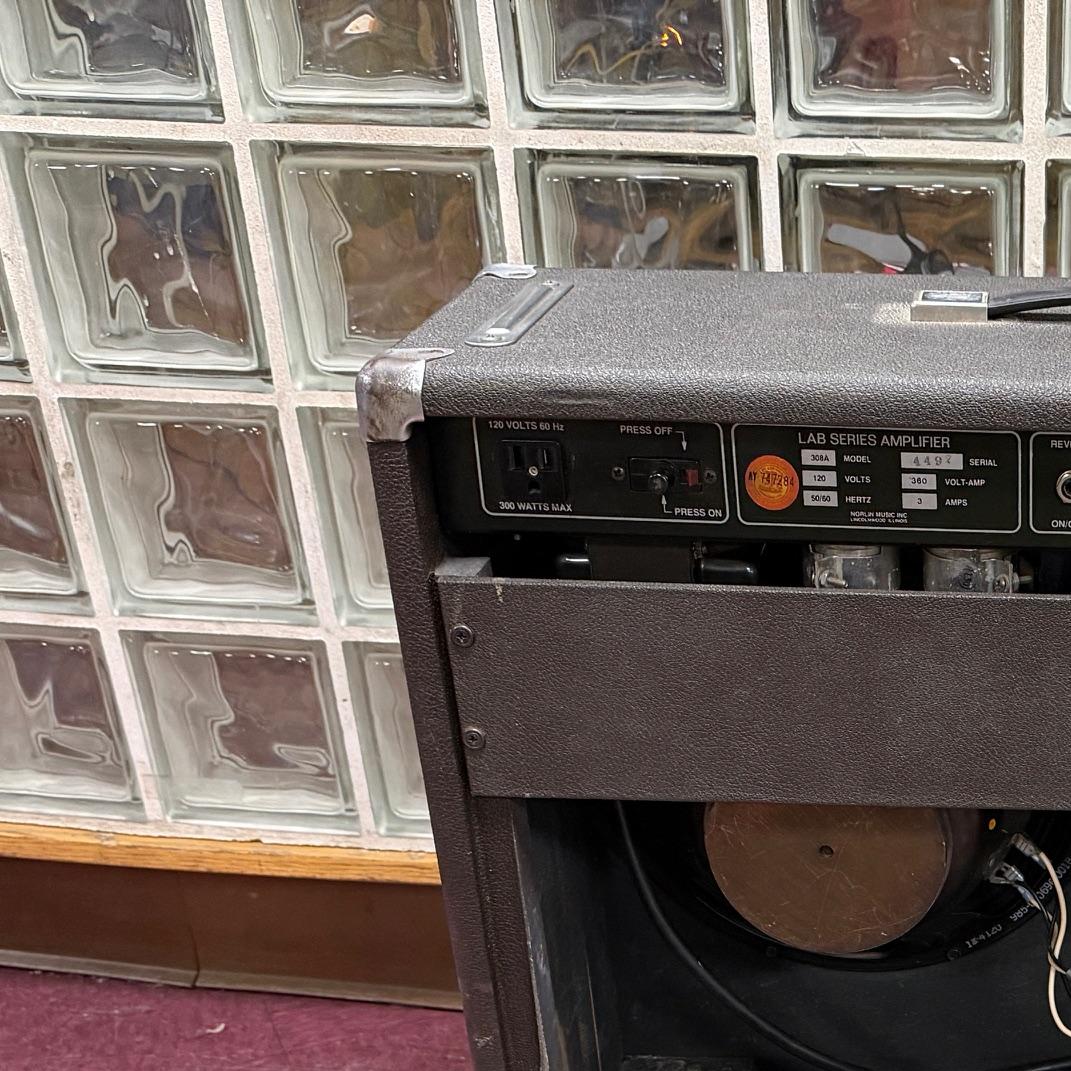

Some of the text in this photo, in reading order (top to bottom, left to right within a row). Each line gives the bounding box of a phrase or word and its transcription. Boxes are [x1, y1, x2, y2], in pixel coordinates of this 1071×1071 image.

[488, 421, 564, 432] 120 VOLTS 60 Hz
[620, 425, 673, 435] PRESS OFF
[798, 432, 951, 448] LAB SERIES AMPLIFIER
[810, 454, 830, 462] 308A
[843, 455, 872, 463] MODEL
[969, 458, 998, 467] SERIAL
[813, 475, 827, 483] 120
[844, 475, 871, 484] VOLTS
[944, 478, 986, 487] VOLT-AMP
[811, 494, 831, 503] 50/60
[845, 496, 872, 504] HERTZ
[916, 498, 923, 506] 3
[944, 498, 969, 507] AMPS
[499, 501, 572, 512] 300 WATTS MAX
[674, 507, 723, 518] PRESS ON
